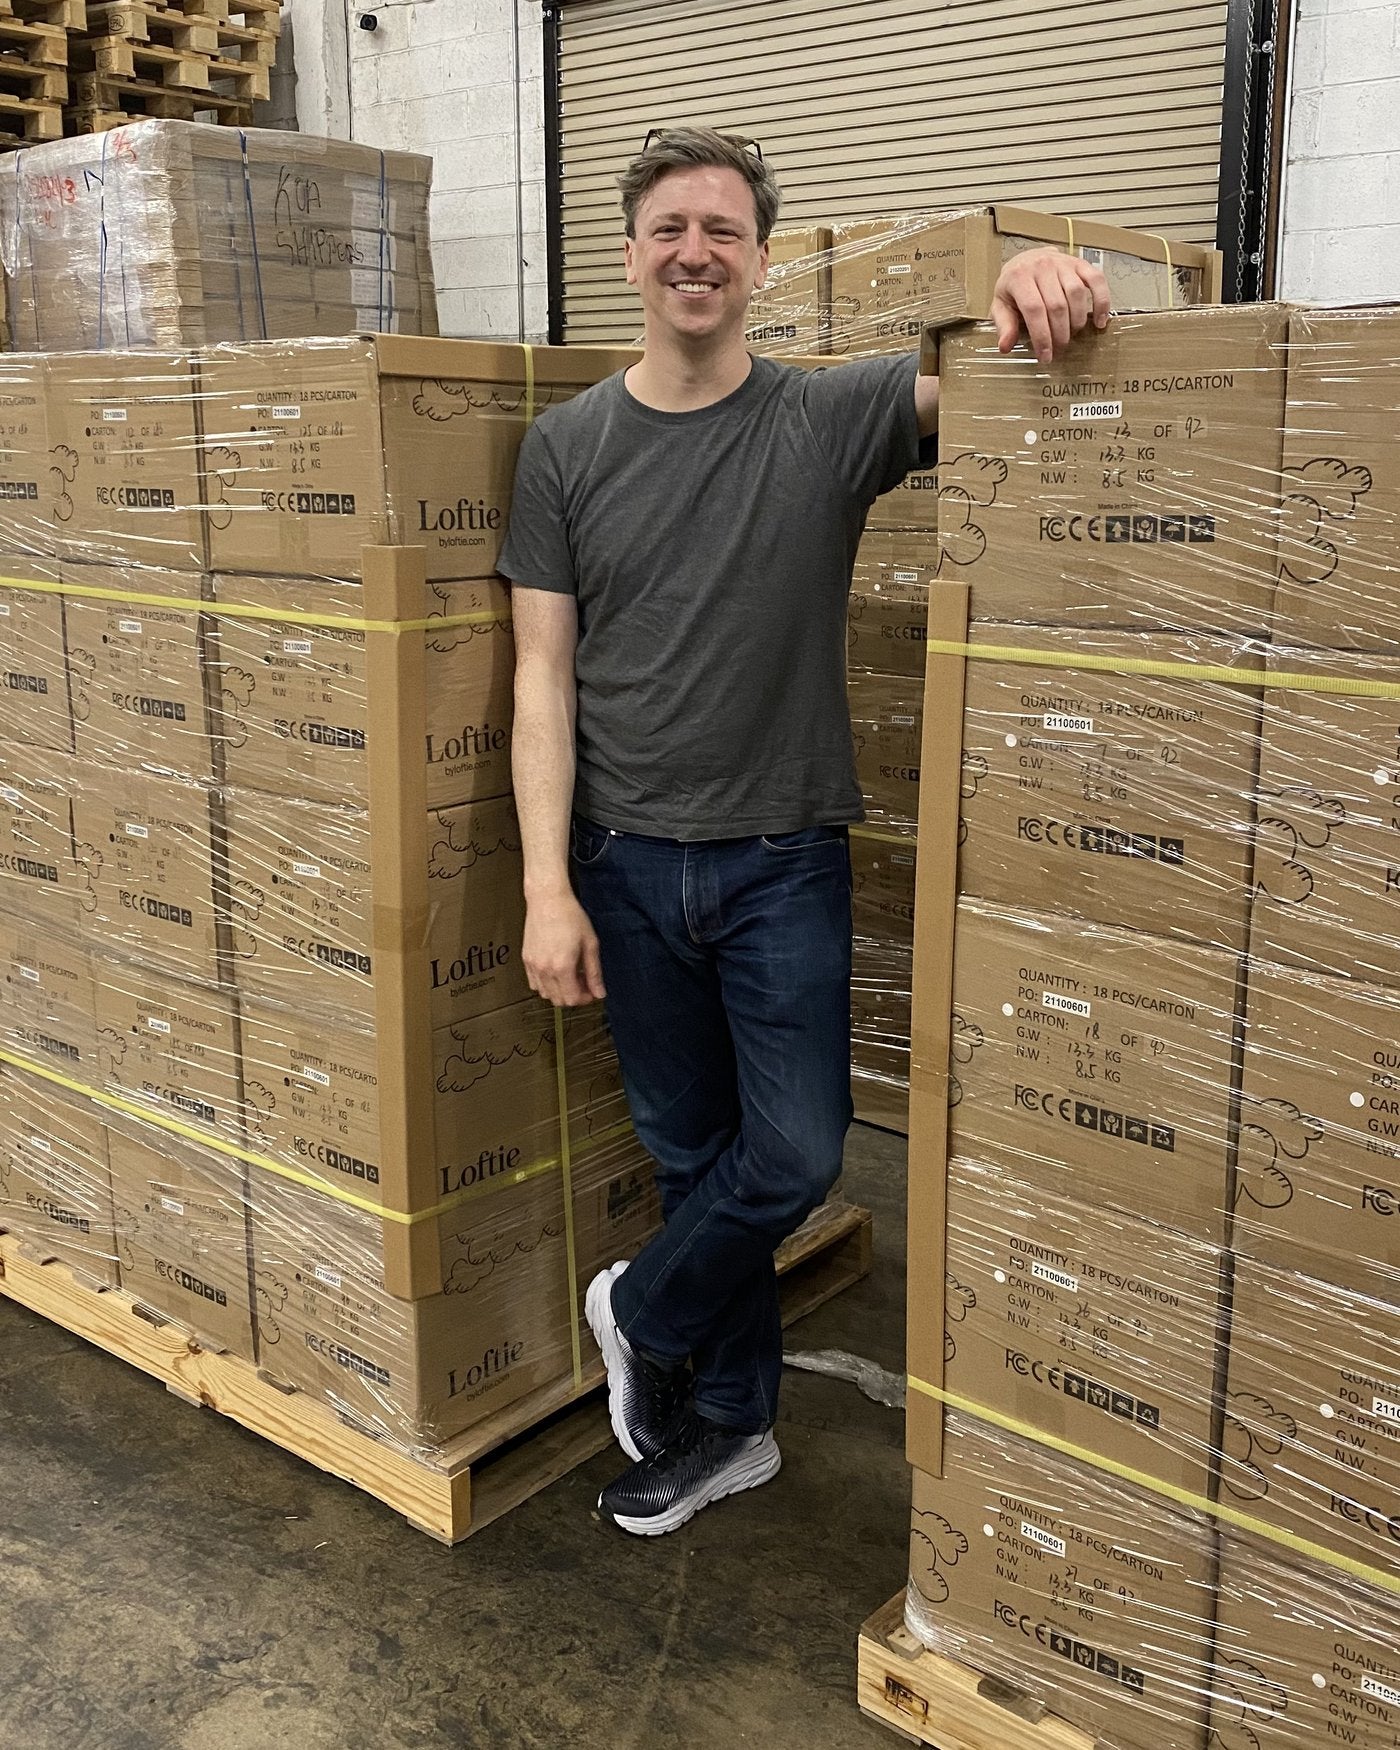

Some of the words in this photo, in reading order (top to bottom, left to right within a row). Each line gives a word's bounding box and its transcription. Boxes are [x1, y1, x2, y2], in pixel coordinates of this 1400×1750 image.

[1123, 380, 1140, 394] 18
[1143, 374, 1234, 394] PCS/CARTON
[310, 390, 357, 402] PCS/CARTON
[1042, 406, 1064, 420] PO:
[1072, 404, 1120, 418] 21100601
[318, 427, 328, 436] OF
[1041, 428, 1097, 442] CARTON:
[1154, 424, 1172, 438] OF
[310, 442, 320, 452] KG
[1137, 448, 1156, 460] KG
[311, 459, 321, 468] KG
[1137, 469, 1156, 482] KG
[418, 498, 501, 532] Loftie
[439, 536, 486, 548] byloftie.com
[1116, 702, 1204, 722] PCS/CARTON
[1020, 716, 1041, 728] PO:
[1046, 717, 1092, 730] 21100601
[426, 723, 506, 765] Loftie
[1126, 748, 1144, 761] OF
[444, 760, 491, 776] byloftie.com
[1110, 766, 1128, 780] KG
[1110, 788, 1128, 800] KG
[430, 941, 510, 990] Loftie
[1018, 986, 1038, 1002] PO:
[1044, 995, 1089, 1014] 21100601
[1093, 986, 1108, 1000] 18
[1112, 989, 1196, 1020] PCS/CARTON
[1017, 1007, 1069, 1031] CARTON:
[1120, 1033, 1138, 1048] OF
[1105, 1050, 1122, 1064] KG
[1104, 1069, 1121, 1083] KG
[338, 1110, 348, 1120] KG
[339, 1124, 348, 1134] KG
[439, 1145, 520, 1196] Loftie
[1033, 1265, 1076, 1290] 21100601
[1082, 1264, 1096, 1278] 18
[1100, 1270, 1180, 1307] PCS/CARTON
[1008, 1276, 1058, 1304] CARTON:
[1092, 1325, 1108, 1342] KG
[448, 1341, 524, 1398] Loftie
[1339, 1386, 1364, 1407] PO:
[998, 1512, 1018, 1530] PO:
[1022, 1524, 1064, 1551] 21100601
[998, 1531, 1046, 1563] CARTON:
[1093, 1578, 1110, 1592] OF
[1069, 1528, 1084, 1543] 18
[1086, 1536, 1164, 1581] PCS/CARTON
[1079, 1588, 1095, 1604] KG
[1078, 1606, 1094, 1622] KG
[1332, 1662, 1356, 1684] PO:
[1330, 1684, 1394, 1724] CARTON:
